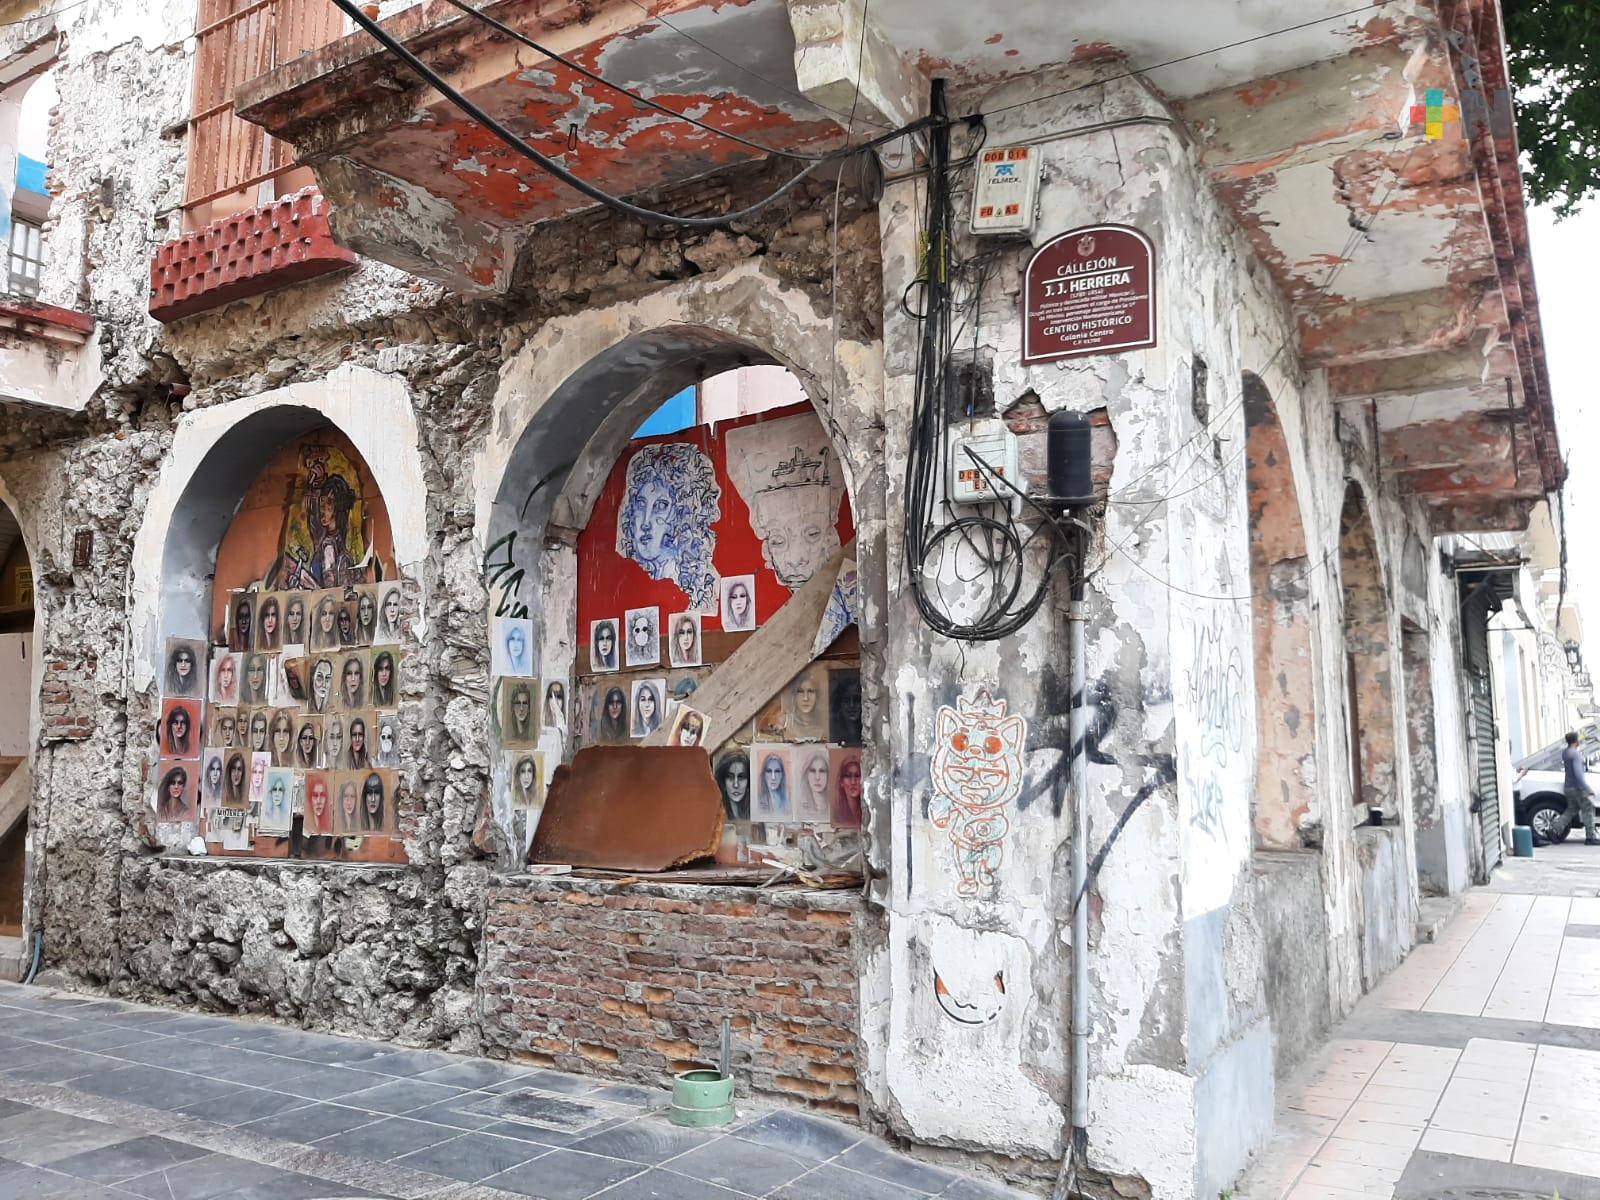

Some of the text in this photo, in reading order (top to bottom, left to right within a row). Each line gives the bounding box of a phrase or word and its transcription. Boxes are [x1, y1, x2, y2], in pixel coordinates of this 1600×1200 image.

[1057, 257, 1117, 276] CALLEJÓN
[1044, 272, 1130, 297] J. J. HERRERA
[1043, 315, 1132, 336] CENTRO HISTÓRICO
[1060, 329, 1114, 342] Colonia Centro
